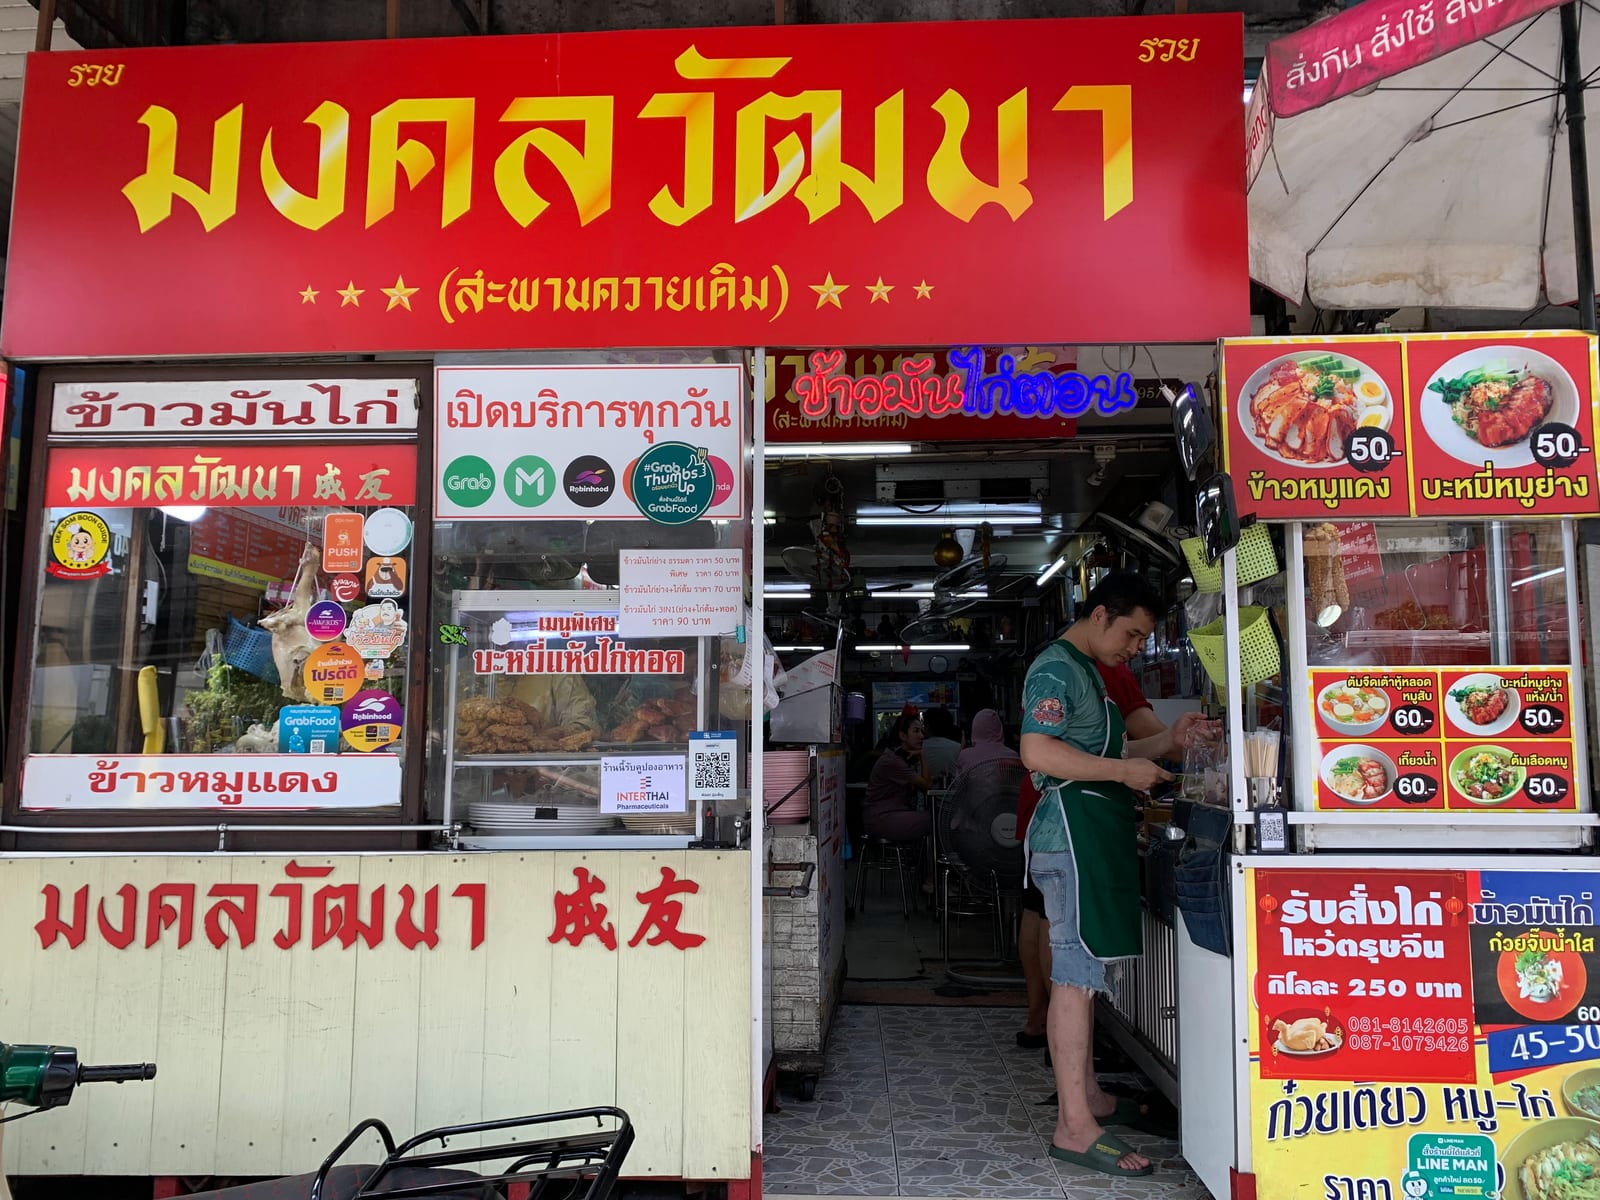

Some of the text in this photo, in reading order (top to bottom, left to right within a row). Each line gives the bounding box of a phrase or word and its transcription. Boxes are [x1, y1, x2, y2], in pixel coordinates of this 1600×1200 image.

[1139, 36, 1201, 63] รวย
[1285, 43, 1363, 90] สั่งกิน
[1370, 5, 1435, 58] สั่งใช้
[68, 63, 127, 87] รวย
[121, 44, 1135, 234] มงคลวัฒนา
[794, 346, 1137, 417] ข้าวมันไก่ตอน
[65, 382, 400, 428] ข้าวมันไก่
[446, 387, 732, 444] เปิดบริการทุกวัน
[1350, 436, 1402, 462] 50.-
[1537, 432, 1590, 459] 50.-
[643, 462, 681, 473] #Grab
[66, 454, 300, 502] มงคลวัฒนา
[447, 472, 491, 490] Grab
[643, 467, 698, 487] Thumbs
[1421, 461, 1589, 509] บะหมี่หมูย่าง
[569, 484, 609, 493] Robinhood
[678, 481, 696, 496] Up
[1248, 471, 1390, 509] ข้าวหมูแดง
[648, 504, 698, 514] GrabFood
[60, 516, 76, 529] SOM
[77, 514, 97, 524] BOON
[96, 522, 108, 544] GUIDE
[327, 547, 359, 557] PUSH
[624, 556, 667, 565] ข้าวมันไก่ย่าง
[696, 557, 713, 565] ราคา
[669, 569, 688, 578] พิเศษ
[714, 585, 724, 593] 70
[624, 604, 656, 613] ข้าวมันไก่
[538, 613, 616, 638] เมนูพิเศษ
[652, 617, 711, 626] ราคา 90 บาท
[473, 636, 685, 674] บะหมี่แห้งไก่ทอด
[312, 665, 358, 682] โปรดีดี
[1347, 675, 1432, 690] ต้มจืดเต้าหู้หลอด
[1501, 673, 1562, 691] บะหมี่หมูย่าง
[1402, 690, 1433, 705] หมูสับ
[1525, 687, 1564, 702] แห้ง/น้ำ
[284, 716, 337, 726] GrabFood
[352, 713, 392, 721] Robinhood
[1394, 709, 1433, 727] 60.-
[1524, 709, 1563, 727] 50.-
[603, 759, 684, 775] ร้านนี้รับคูปองอาหาร
[1511, 754, 1568, 769] ต้มเลือดหมู
[88, 760, 339, 806] ข้าวหมูแดง
[1398, 778, 1437, 795] 60.-
[1528, 778, 1568, 796] 50.-
[617, 791, 669, 801] INTERTHAI
[34, 859, 487, 952] มงคลวัฒนา
[1281, 884, 1443, 926] รับสั่งไก่
[1474, 889, 1594, 926] ข้าวมันไก่
[1280, 928, 1444, 964] ไหว้ตรุษจีน
[1489, 928, 1594, 953] ก๋วยจั๊บน้ำใส
[1268, 971, 1463, 998] กิโลละ 250 บาท
[1348, 1017, 1468, 1034] 081-8142605
[1349, 1035, 1469, 1052] 087-1073426
[1266, 1079, 1427, 1140] ก๋วยเตยว
[1416, 1158, 1488, 1172] LINE MAN
